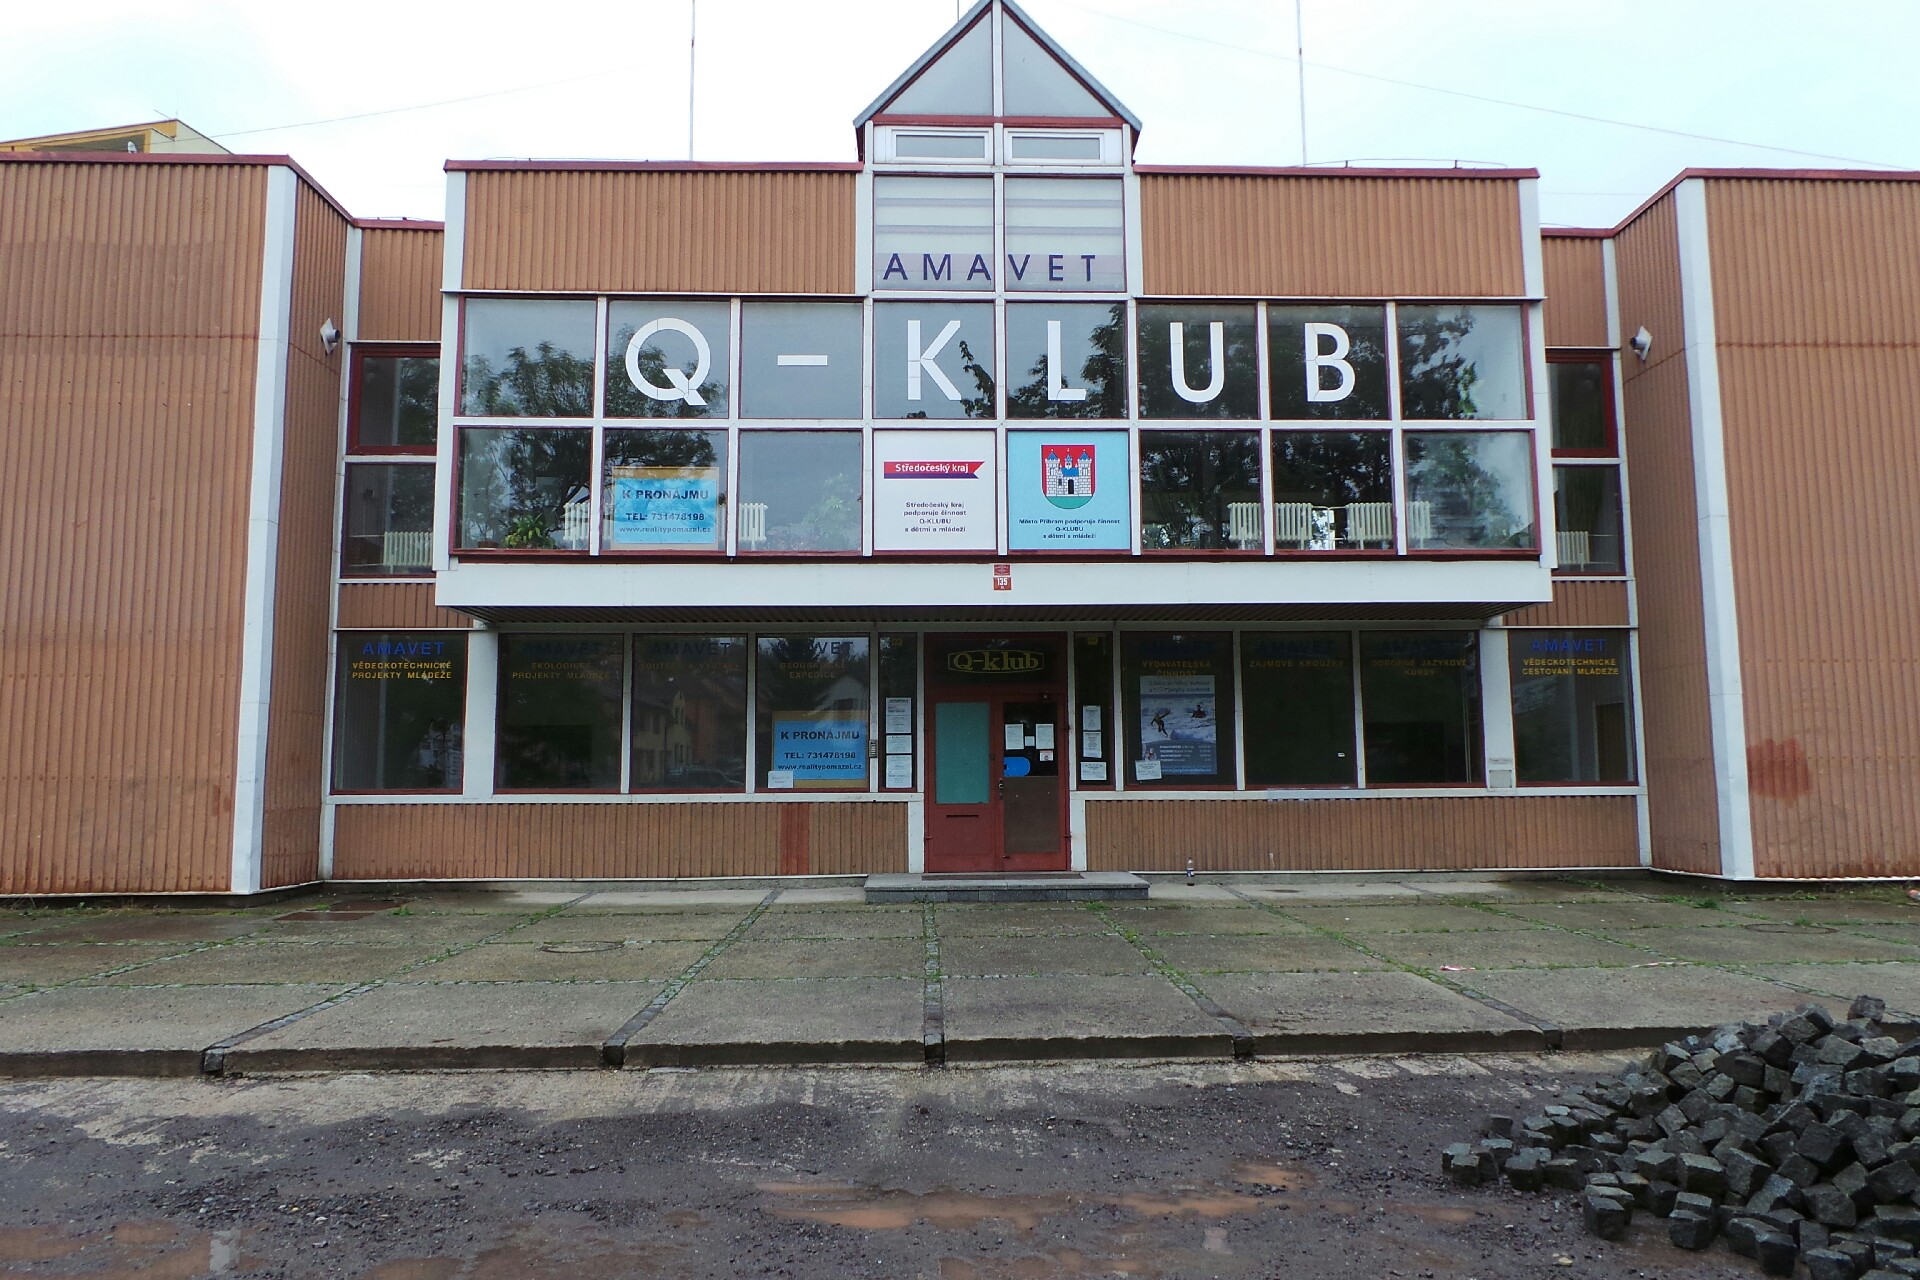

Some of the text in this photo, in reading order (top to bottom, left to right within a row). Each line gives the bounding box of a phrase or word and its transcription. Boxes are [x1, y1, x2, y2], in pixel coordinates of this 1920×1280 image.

[883, 252, 1096, 282] AMAVET
[895, 463, 969, 474] Středočeský kraj
[622, 488, 709, 500] K PRONÁJMU
[905, 501, 965, 509] Středočeský kraj
[625, 512, 705, 521] TEL: 731478198
[619, 526, 712, 534] www.realitypomazal.cz
[997, 577, 1008, 586] 135
[362, 641, 444, 655] AMAVET
[649, 642, 731, 655] AMAVET
[1531, 639, 1606, 652] AMAVET
[352, 660, 452, 669] VĚDECKOTECHNICKÉ
[953, 651, 1039, 671] Q-klub
[1523, 657, 1617, 666] VĚDECKOTECHNICKÉ
[352, 670, 452, 679] PROJEKTY MLÁDEŽE
[511, 671, 561, 679] PROJEKTY
[780, 729, 860, 740] K PRONÁJMU
[807, 751, 857, 759] 731478198
[777, 763, 862, 771] www.realitypomazal.cz
